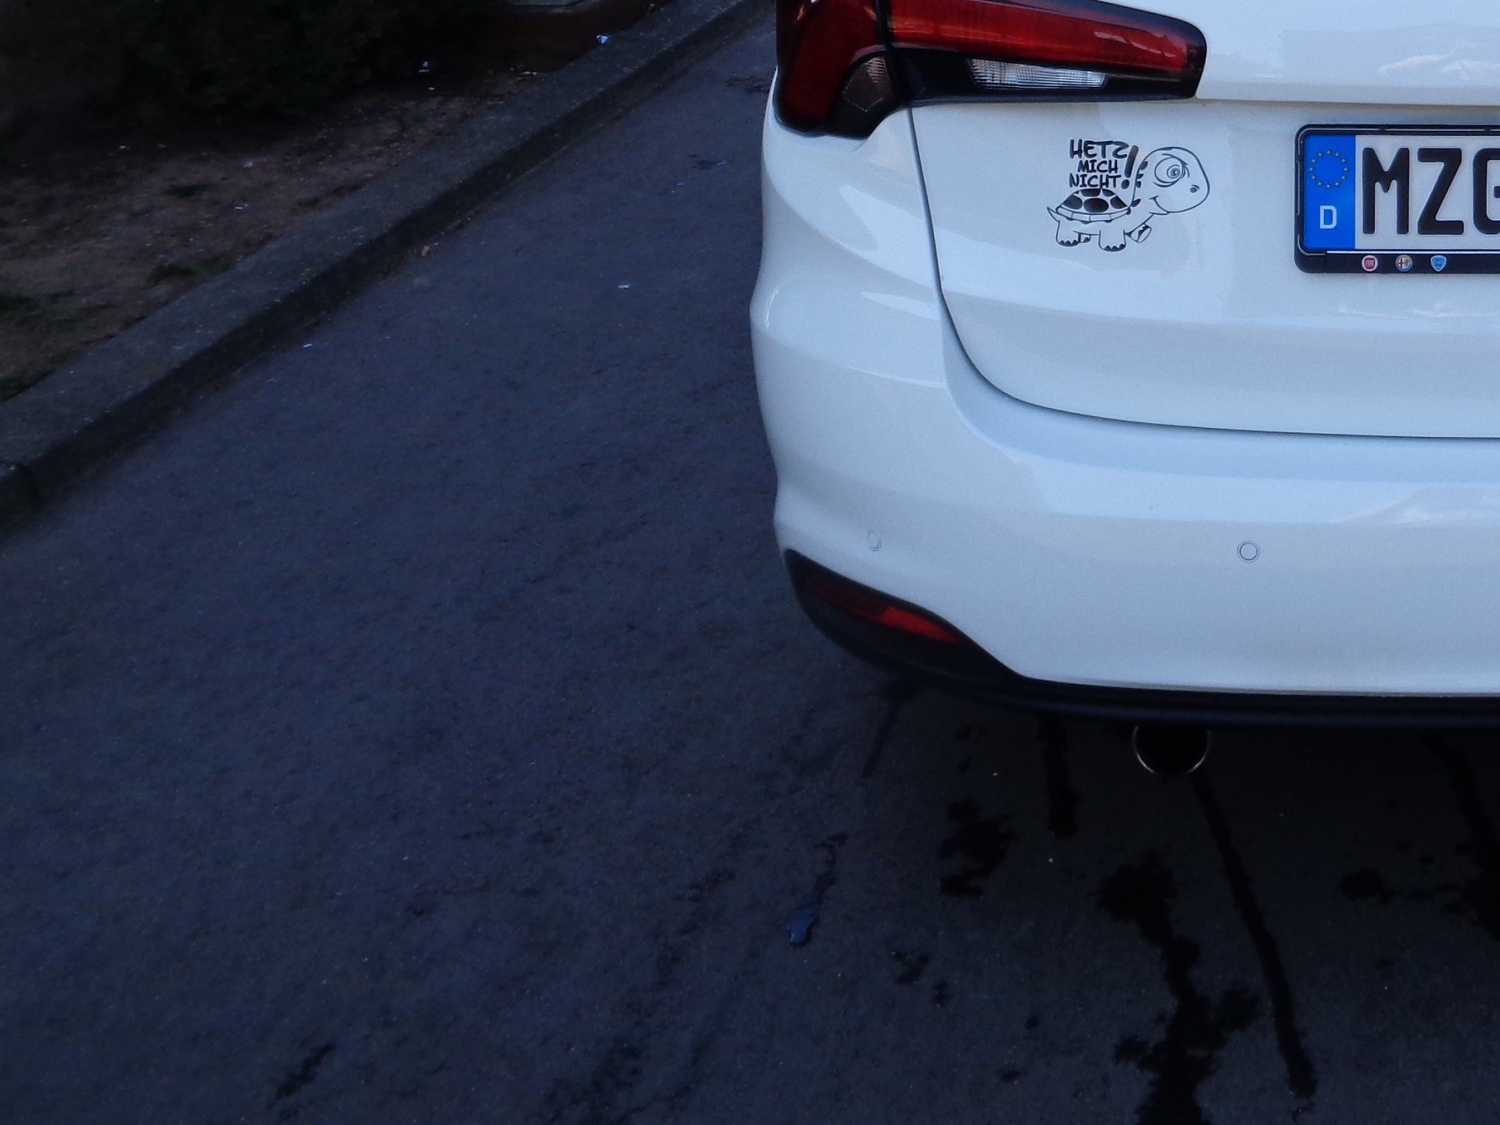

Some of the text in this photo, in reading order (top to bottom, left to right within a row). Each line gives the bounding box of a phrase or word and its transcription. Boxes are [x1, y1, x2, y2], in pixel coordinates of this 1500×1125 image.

[1069, 139, 1130, 159] HETZ
[1077, 159, 1119, 174] MICH
[1319, 205, 1337, 230] D
